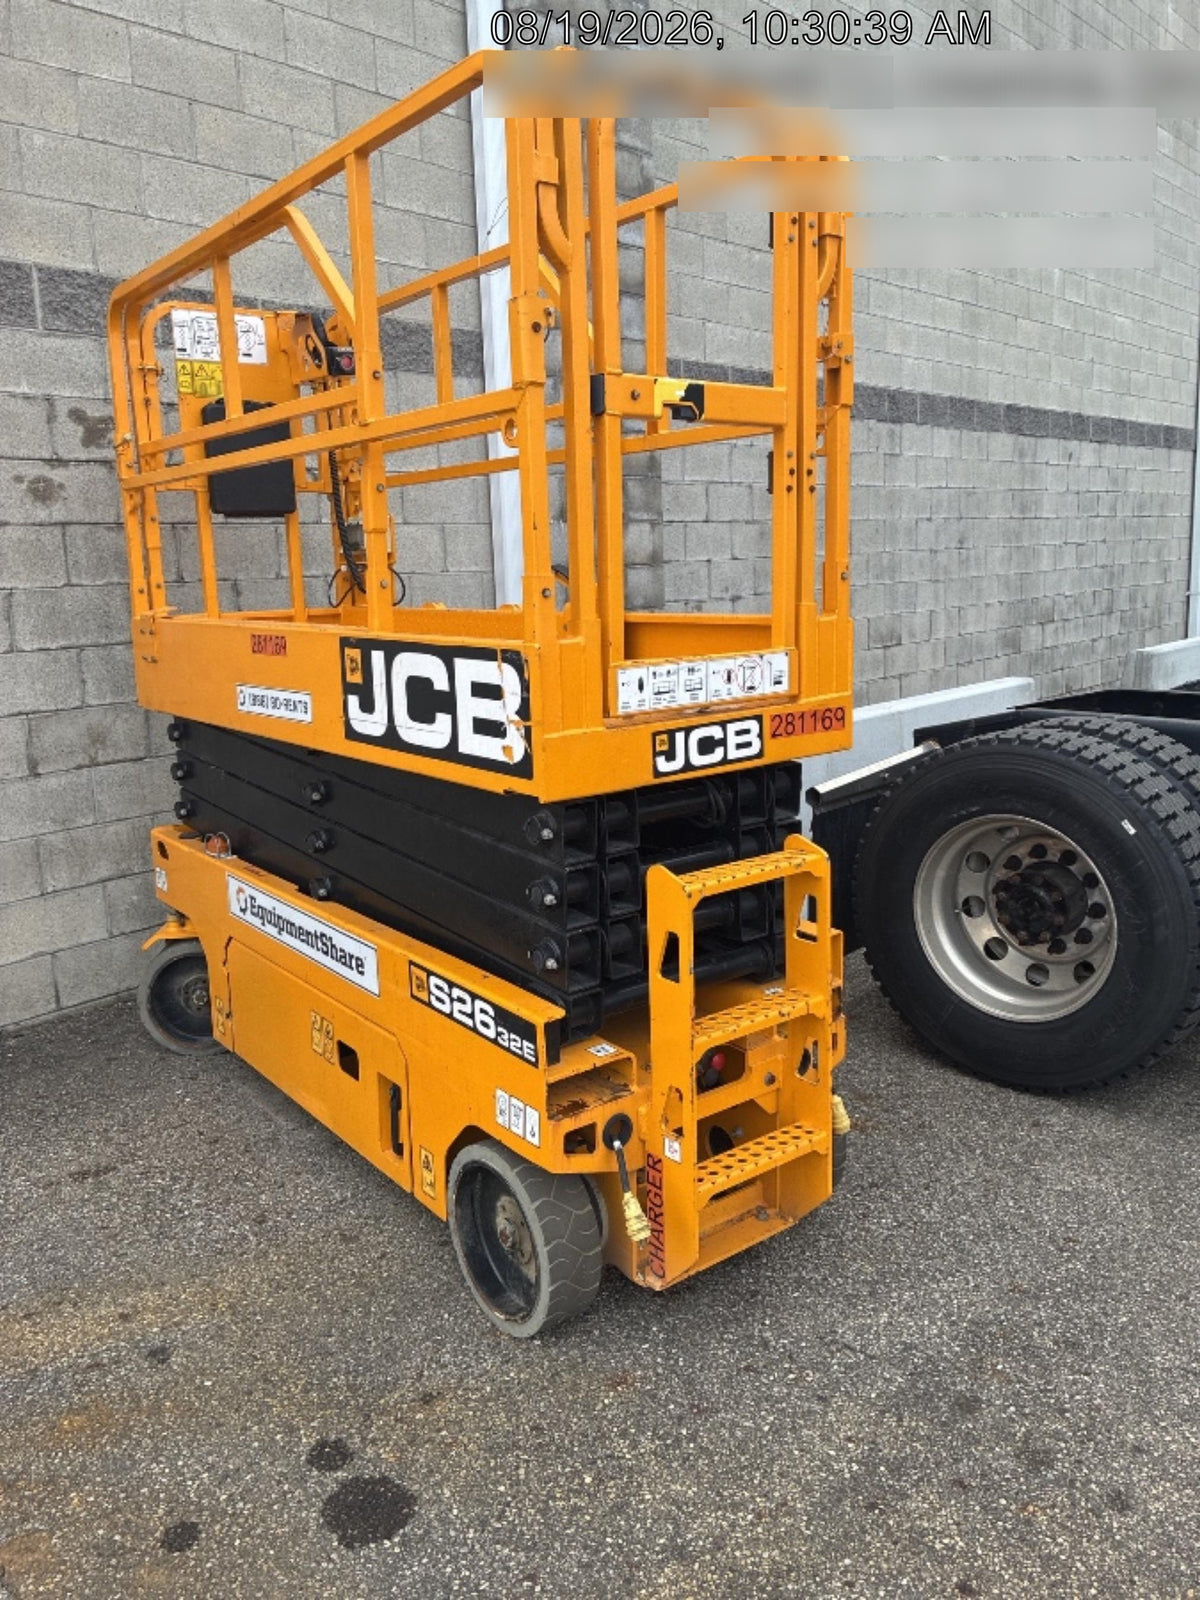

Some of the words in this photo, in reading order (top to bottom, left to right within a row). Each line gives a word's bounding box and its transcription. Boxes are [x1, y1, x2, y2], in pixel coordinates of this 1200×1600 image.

[347, 649, 526, 765] JCB
[655, 718, 763, 773] JCB
[770, 707, 846, 738] 281169
[248, 893, 366, 977] EquipmentShare
[646, 1152, 666, 1280] CHARGER
